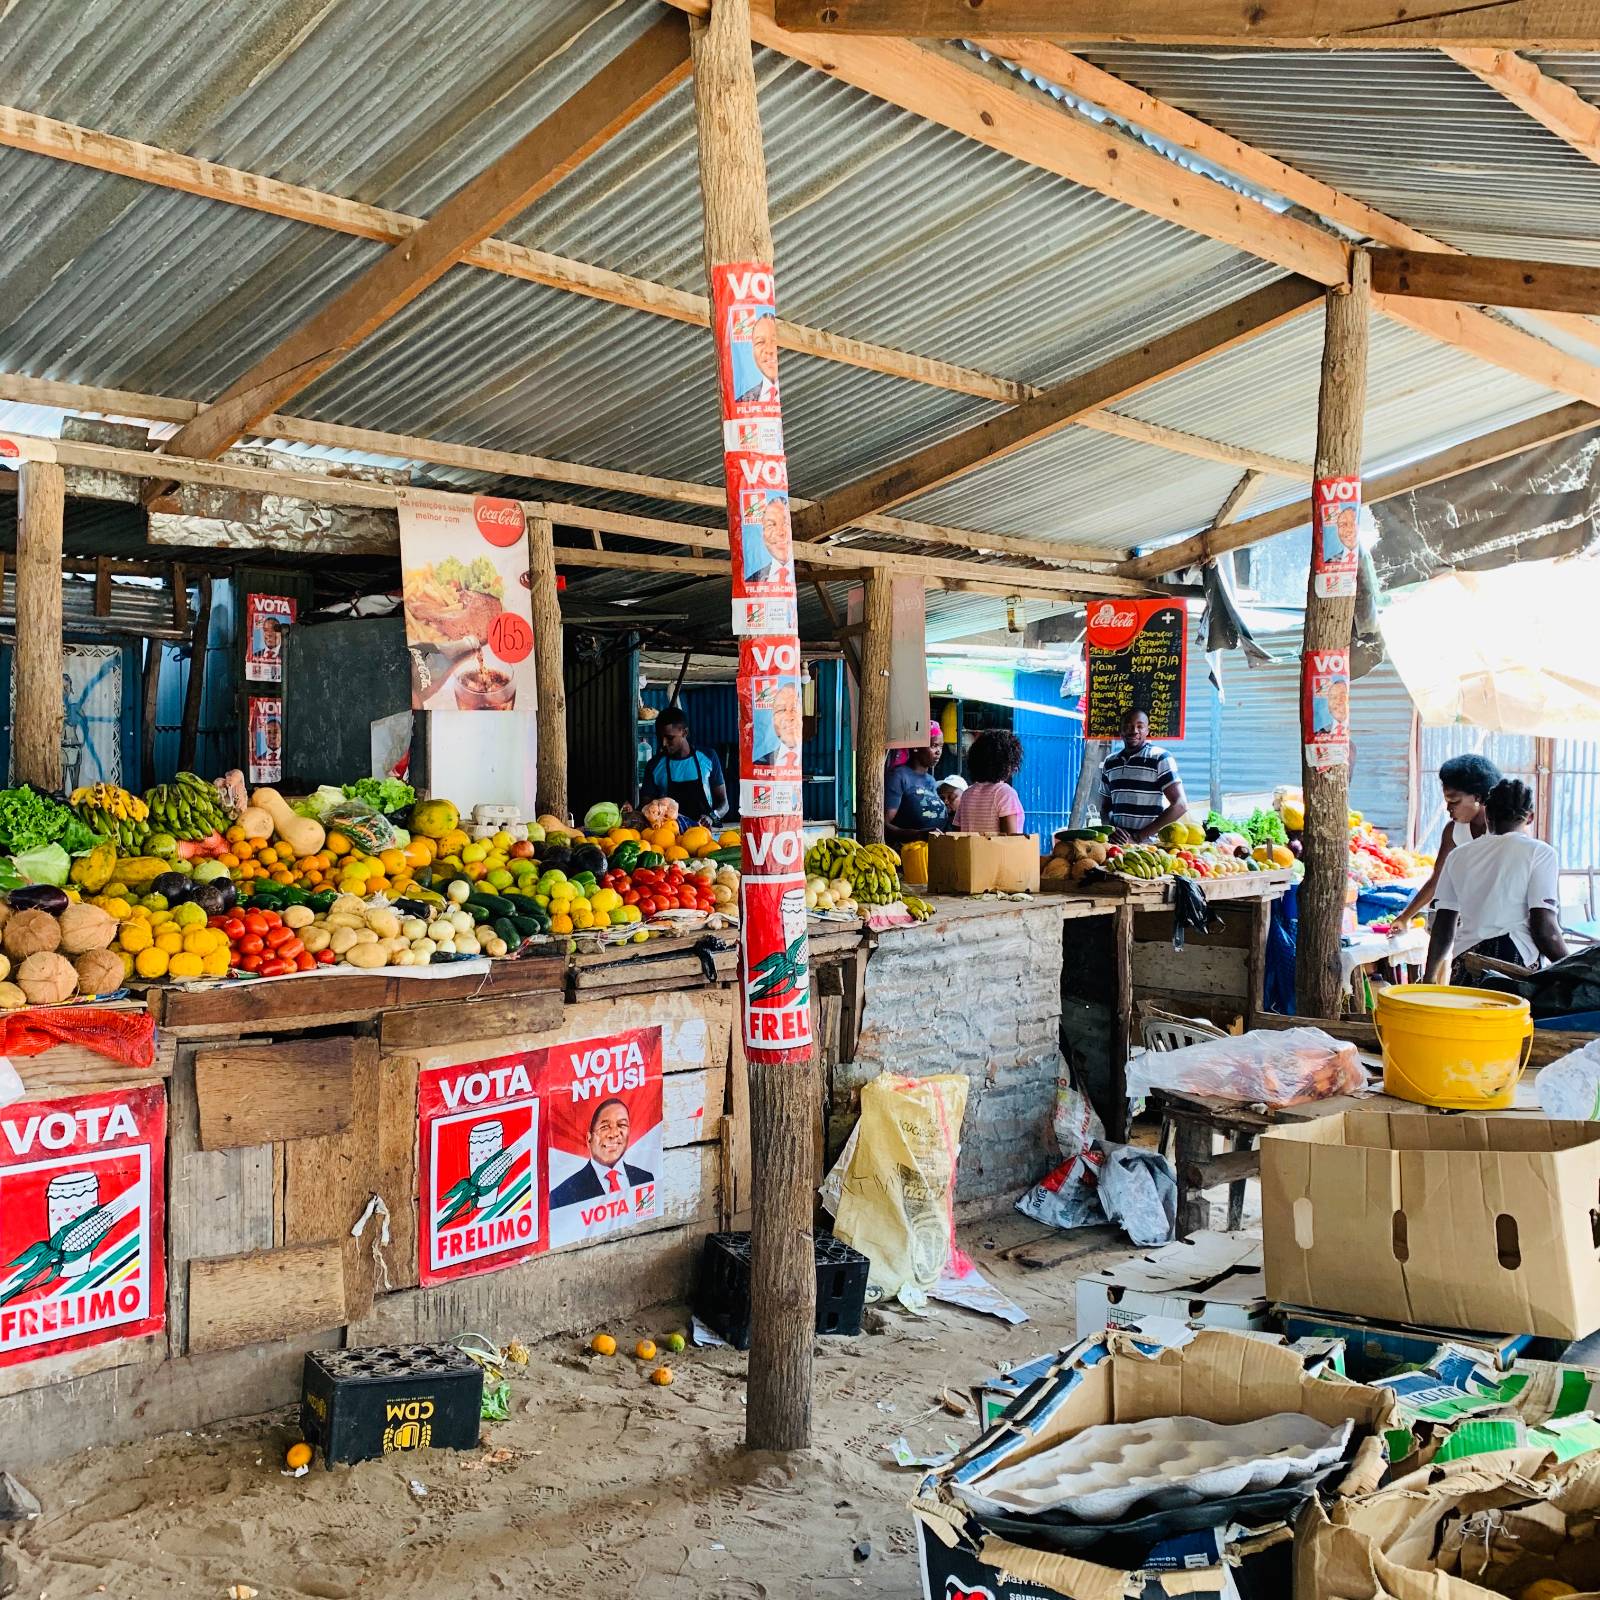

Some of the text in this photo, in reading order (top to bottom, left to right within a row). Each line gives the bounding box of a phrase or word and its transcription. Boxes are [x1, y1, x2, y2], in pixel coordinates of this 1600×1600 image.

[740, 459, 788, 485] VO
[253, 598, 291, 614] VOTA
[492, 616, 525, 653] 165
[751, 645, 801, 672] VO
[570, 1042, 644, 1079] VOTA
[439, 1064, 533, 1109] VOTA
[572, 1065, 646, 1103] NYUSI
[1, 1103, 141, 1156] VOTA
[581, 1199, 629, 1227] VOTA
[437, 1214, 533, 1262] FRELIMO
[0, 1285, 142, 1343] FRELIMO
[386, 1401, 435, 1422] CDM
